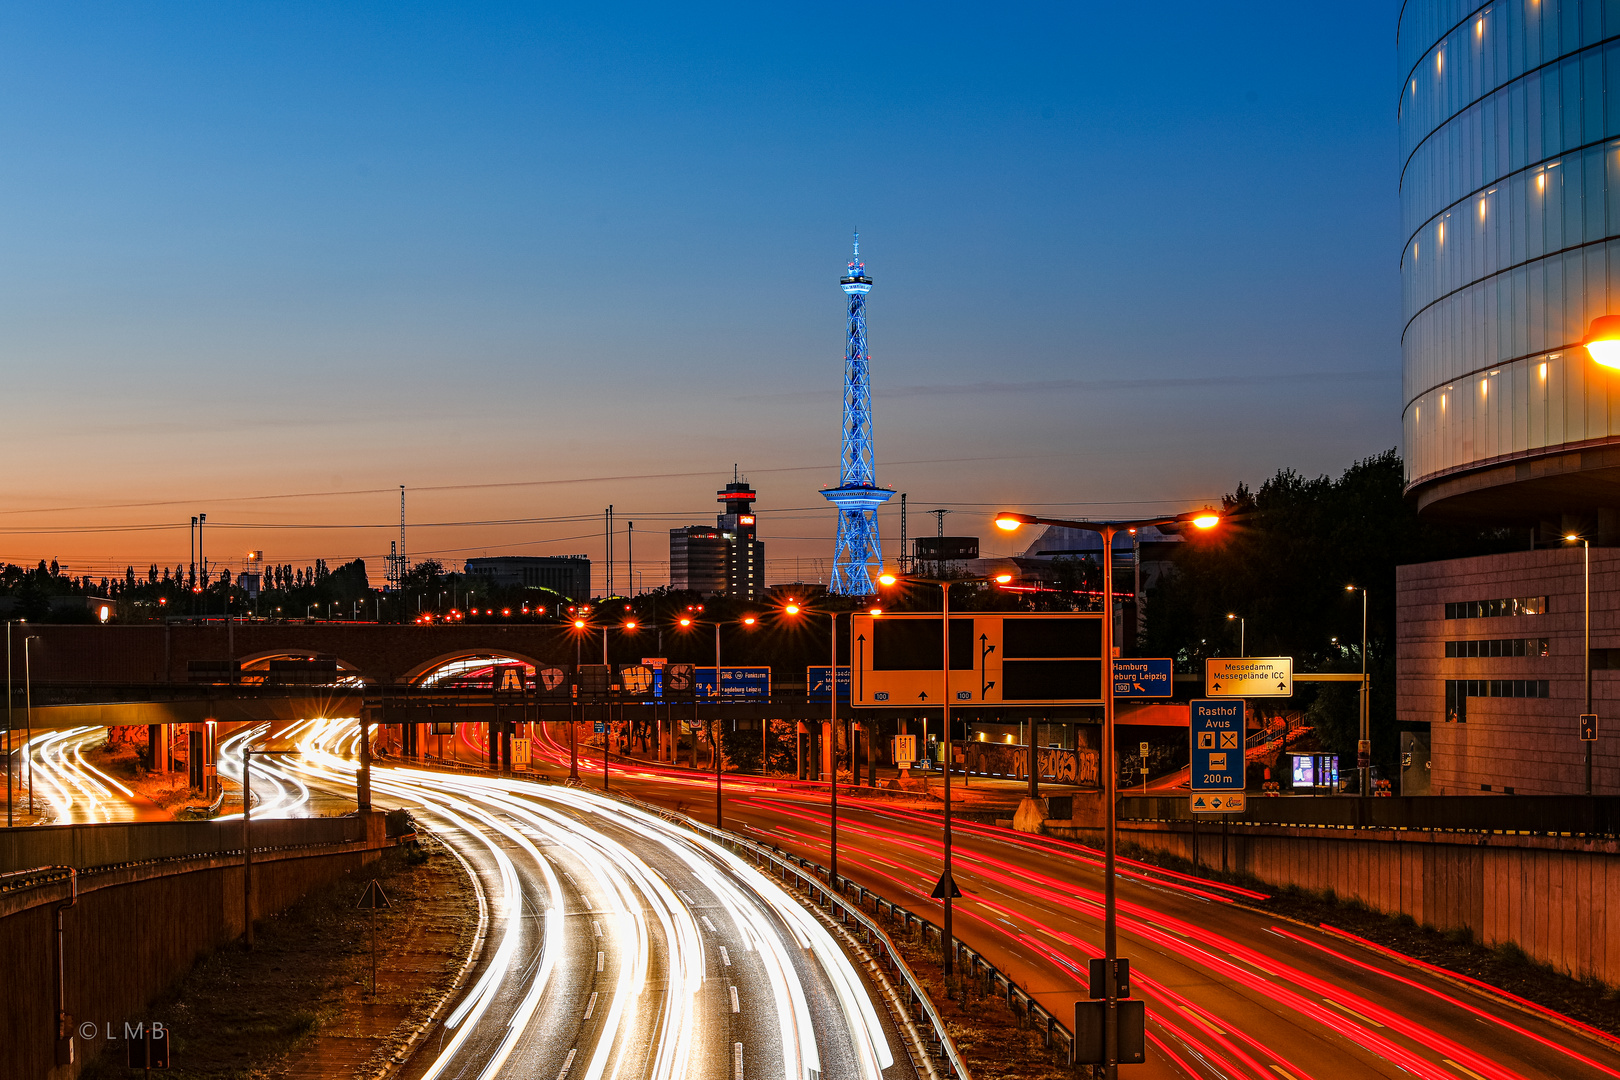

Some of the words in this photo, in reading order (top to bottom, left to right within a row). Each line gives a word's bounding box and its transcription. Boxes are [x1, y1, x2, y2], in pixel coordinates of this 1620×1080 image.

[1113, 663, 1148, 672] Hamburg
[1113, 672, 1137, 681] eburg
[1139, 672, 1167, 681] Leipzig
[1214, 672, 1269, 681] Messegelände
[1198, 706, 1237, 716] Rasthof
[1205, 719, 1231, 728] Avus
[1203, 774, 1221, 783] 200
